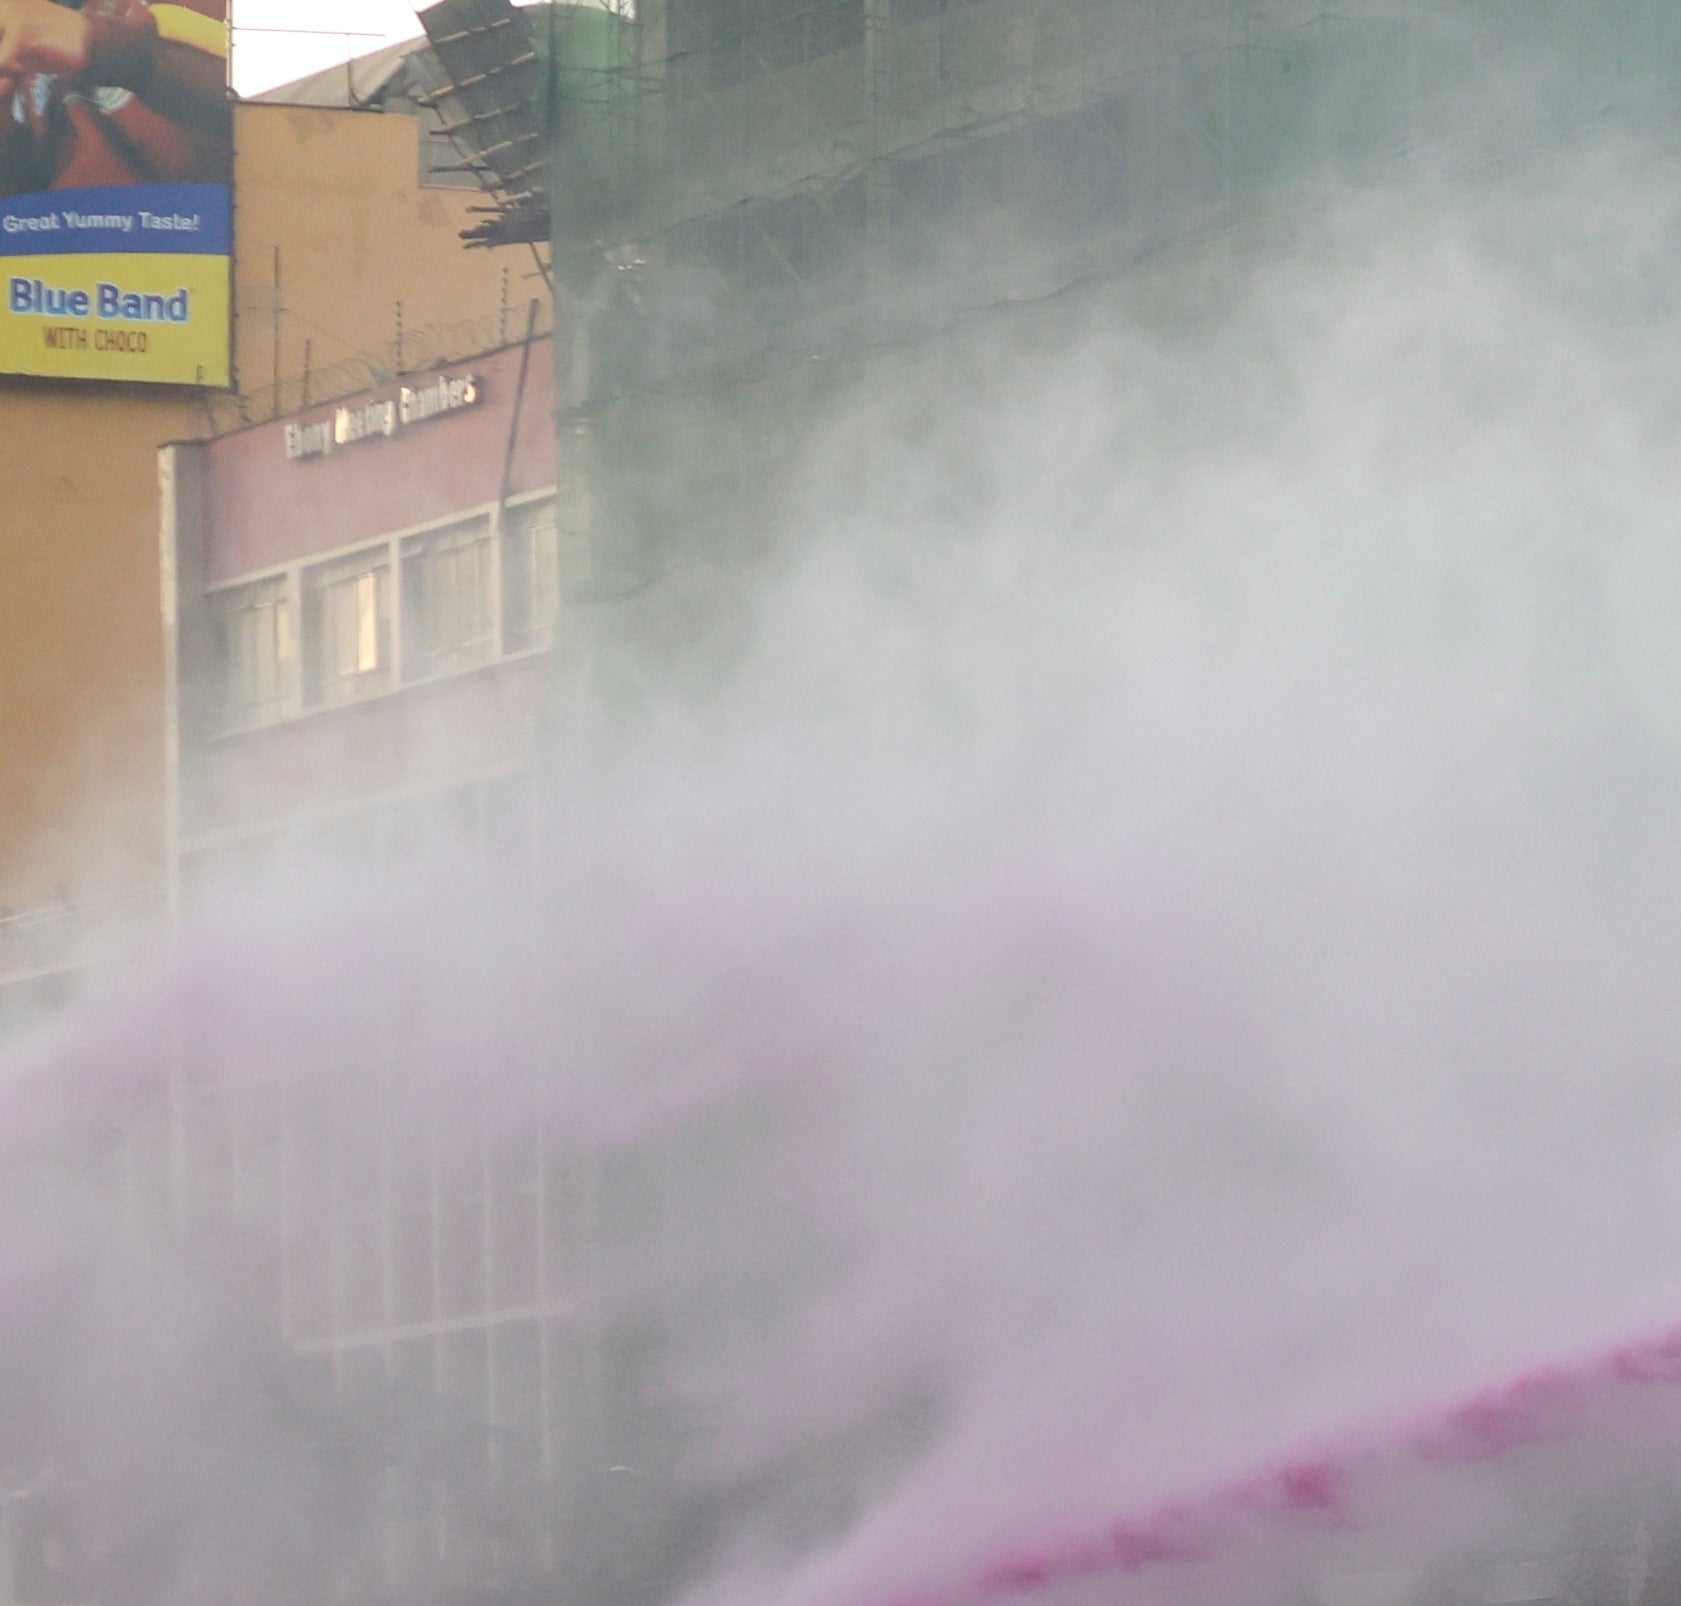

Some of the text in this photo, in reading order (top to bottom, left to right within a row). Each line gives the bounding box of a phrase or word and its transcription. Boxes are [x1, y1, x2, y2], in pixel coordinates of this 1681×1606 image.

[2, 211, 200, 232] Great Yummy Taste!
[9, 276, 189, 323] Blue Band
[42, 326, 147, 353] WITH CHOCO
